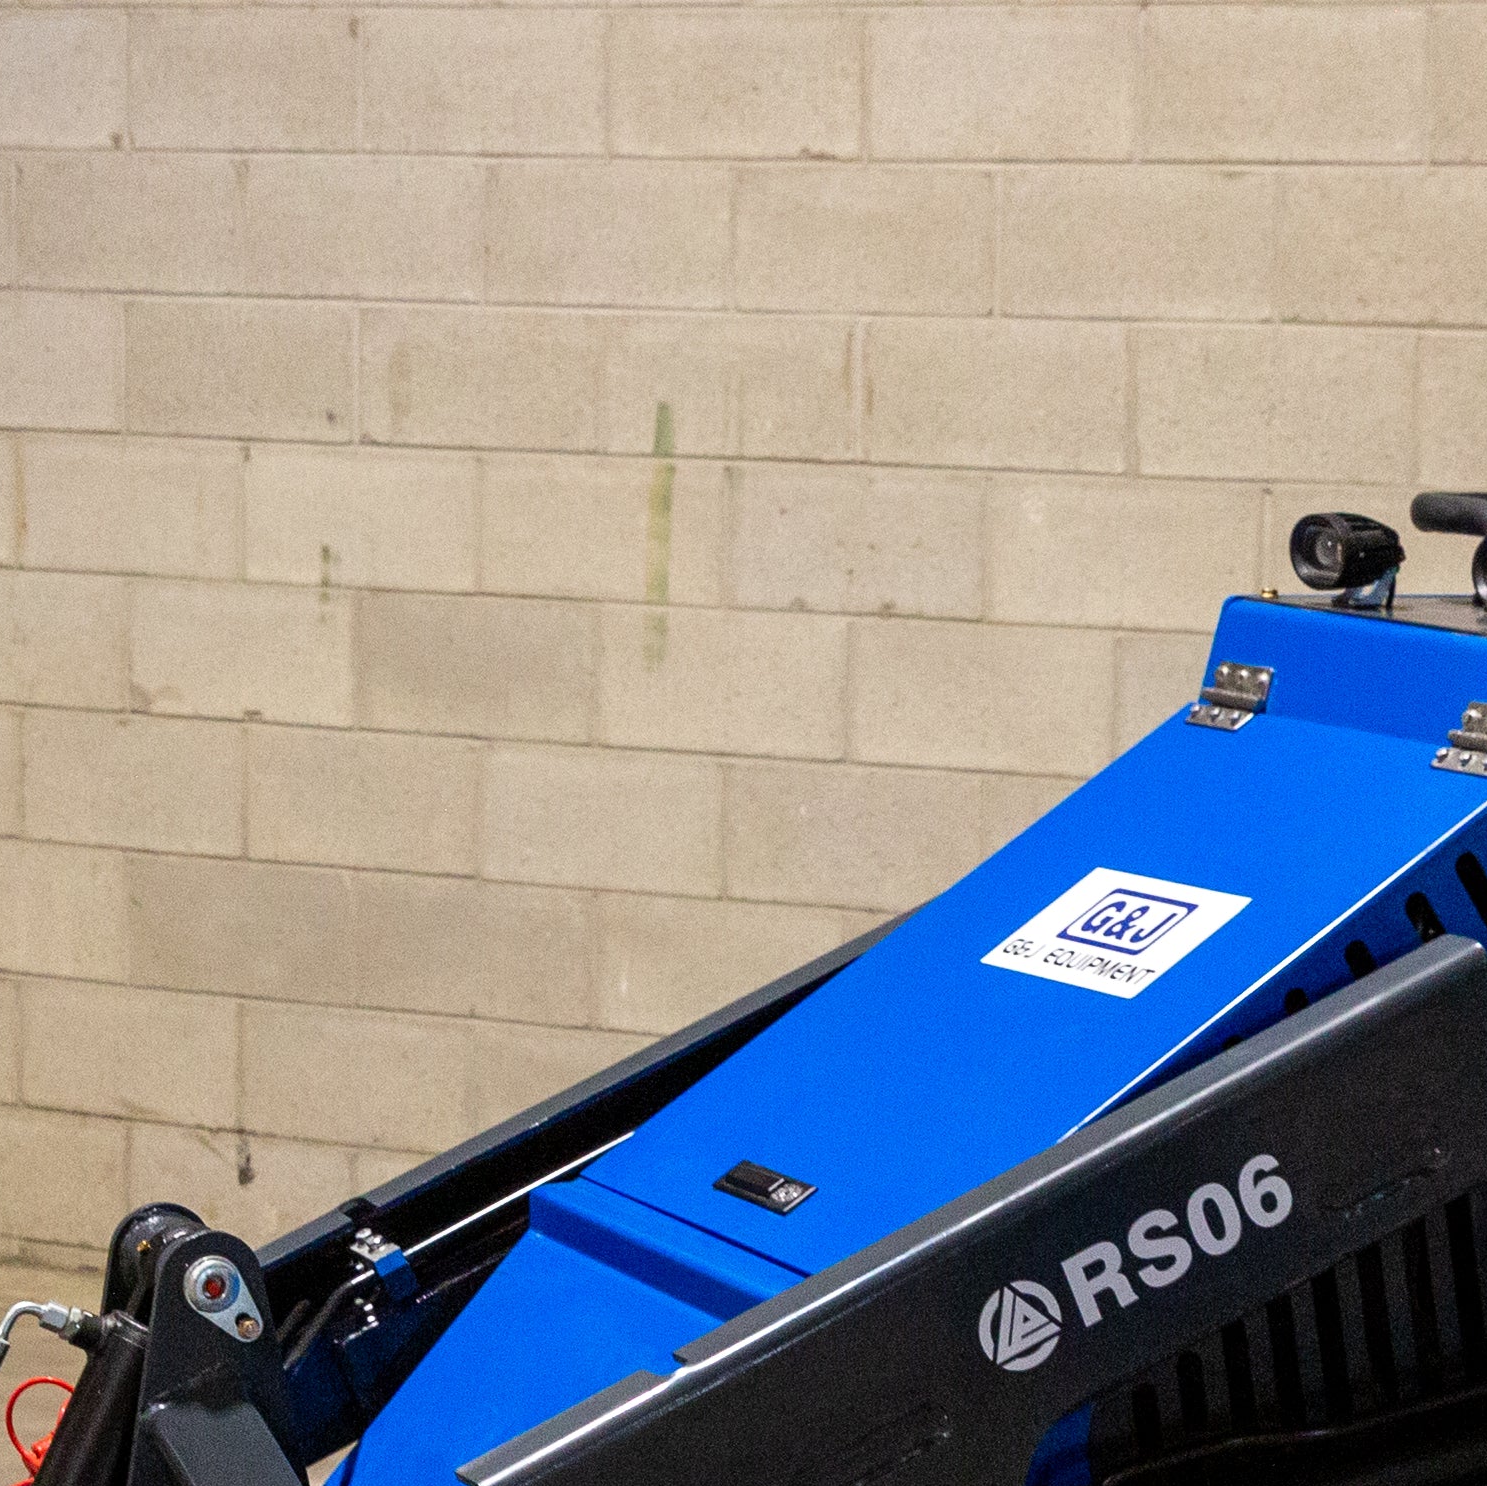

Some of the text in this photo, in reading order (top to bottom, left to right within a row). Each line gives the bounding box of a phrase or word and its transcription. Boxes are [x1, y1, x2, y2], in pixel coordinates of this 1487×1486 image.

[1081, 900, 1177, 943] G&J
[1003, 938, 1155, 984] G&J EQUIPMENT
[1060, 1153, 1293, 1328] RS06
